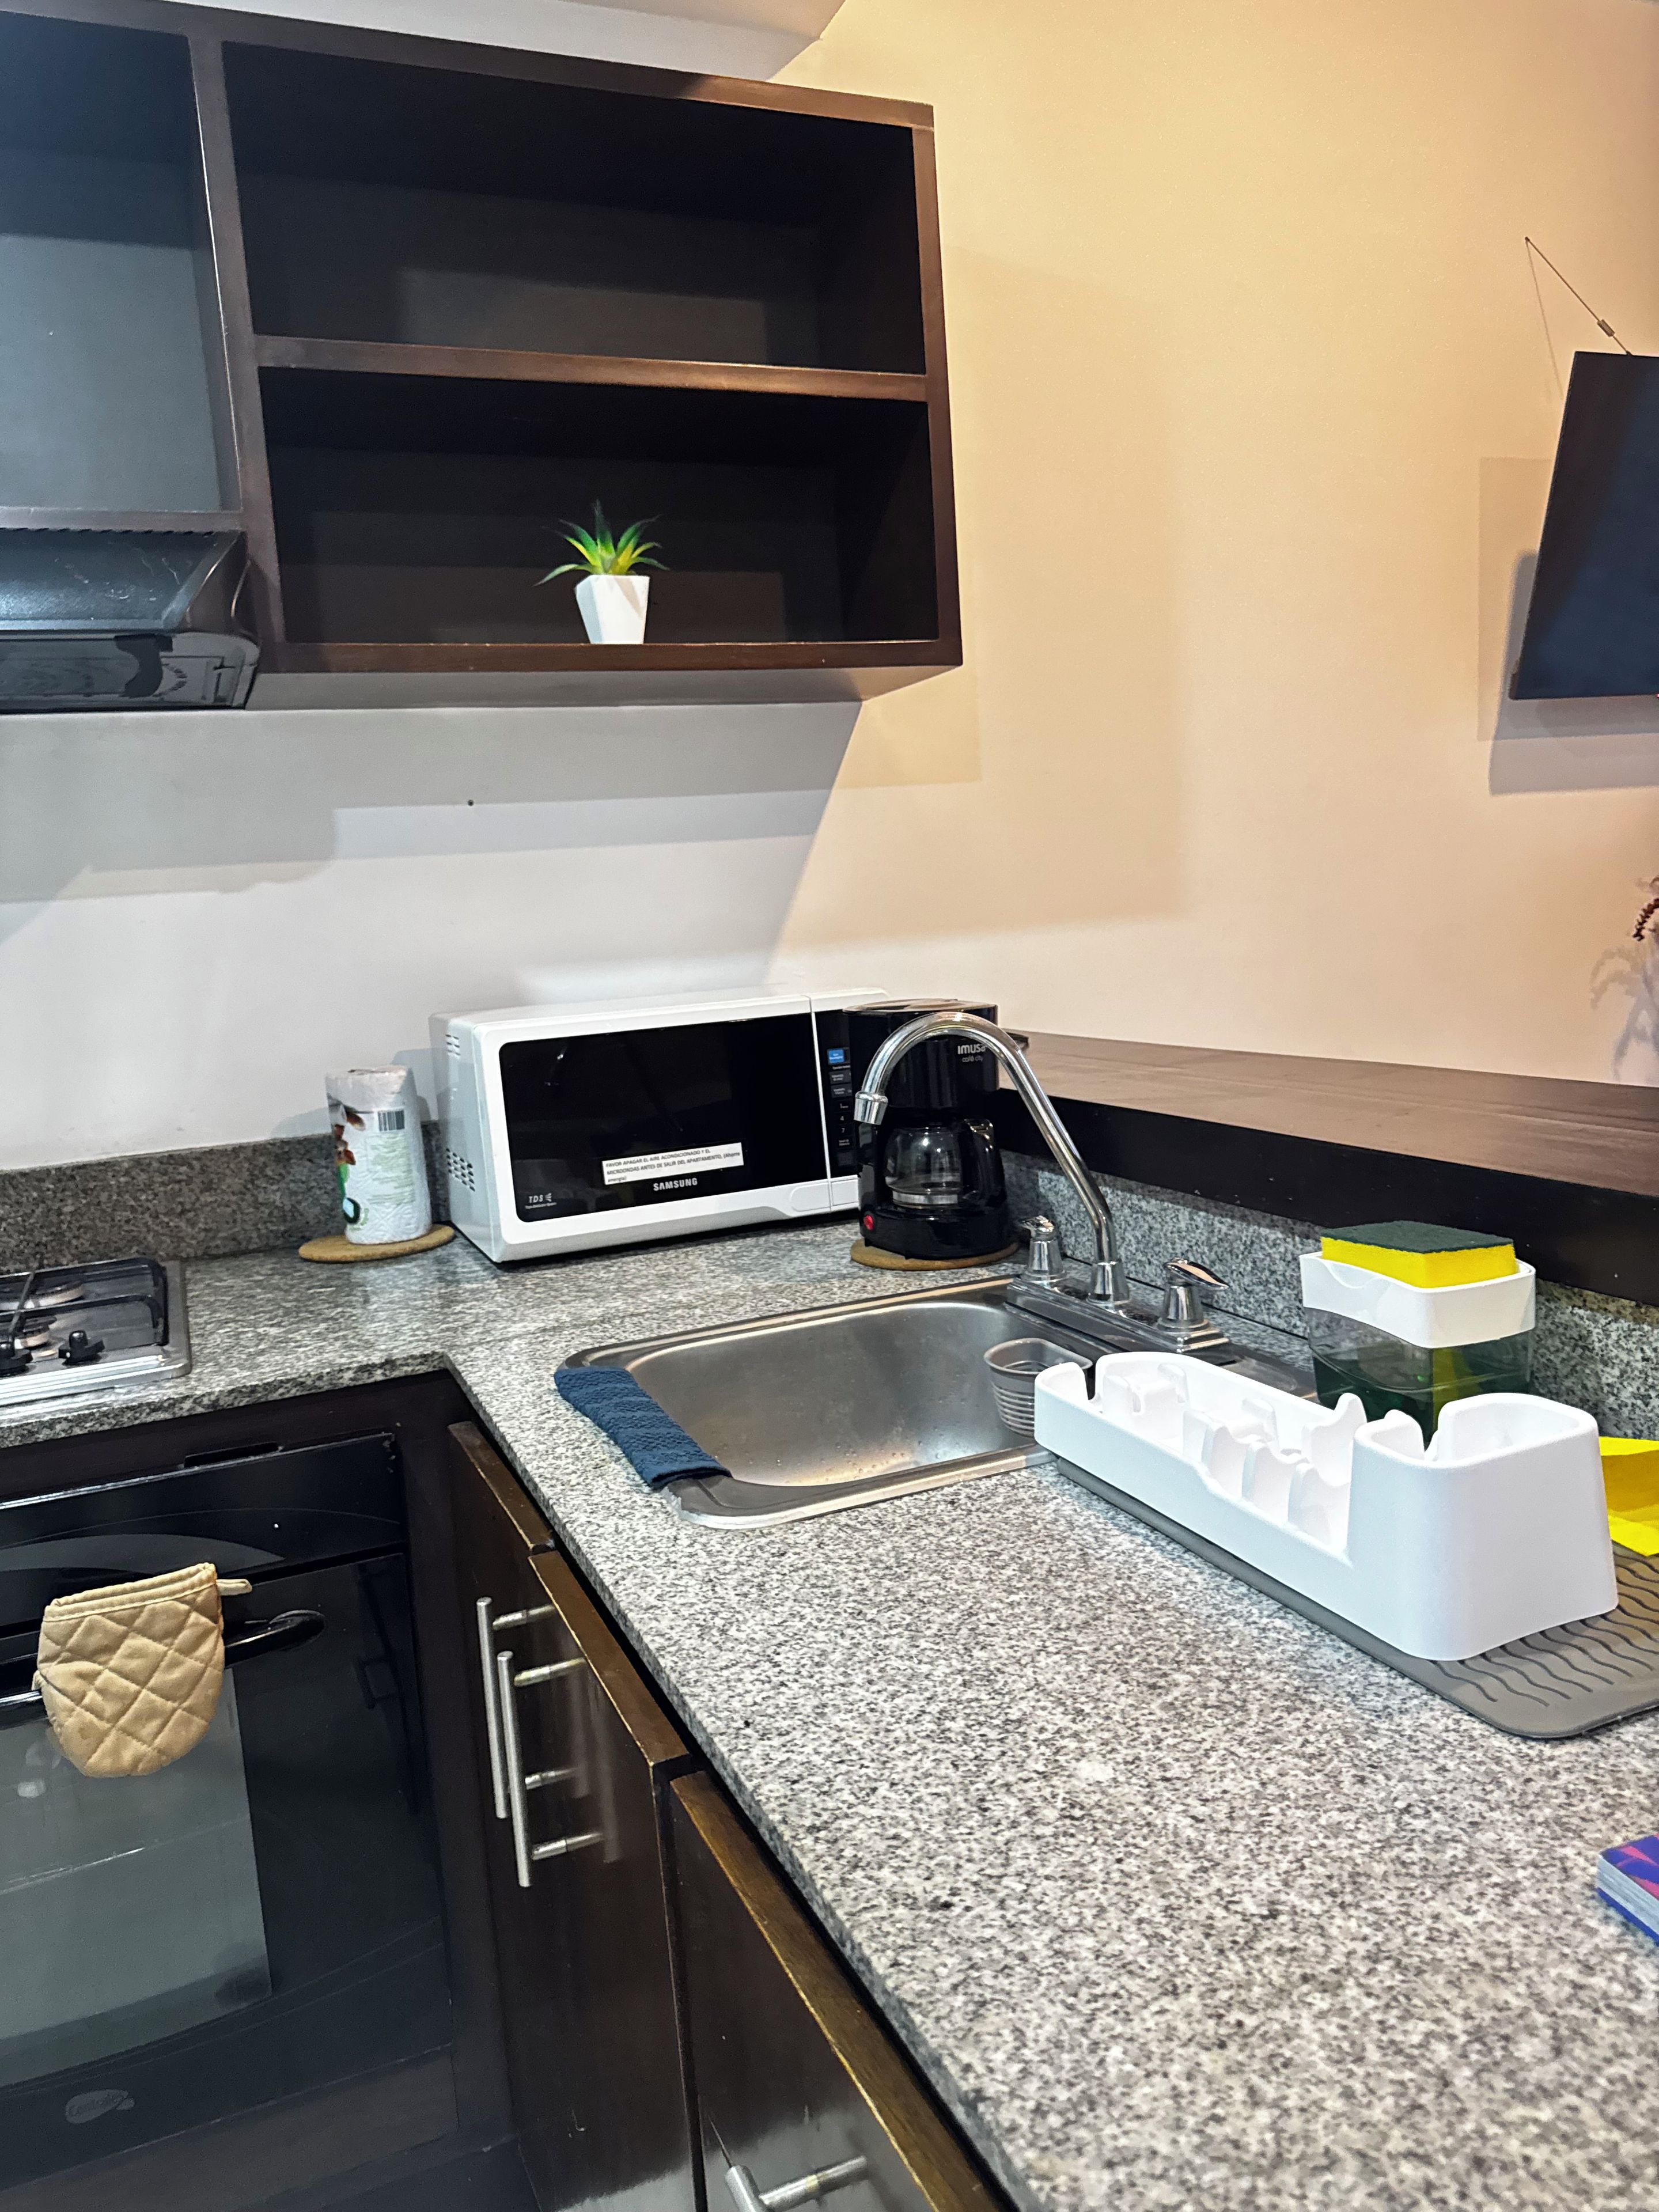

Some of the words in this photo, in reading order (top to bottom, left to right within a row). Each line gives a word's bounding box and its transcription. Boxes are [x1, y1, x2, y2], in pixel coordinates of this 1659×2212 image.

[607, 1166, 641, 1175] MICROONDAS
[653, 1177, 698, 1191] SAMSUNG
[528, 1194, 543, 1203] TDS
